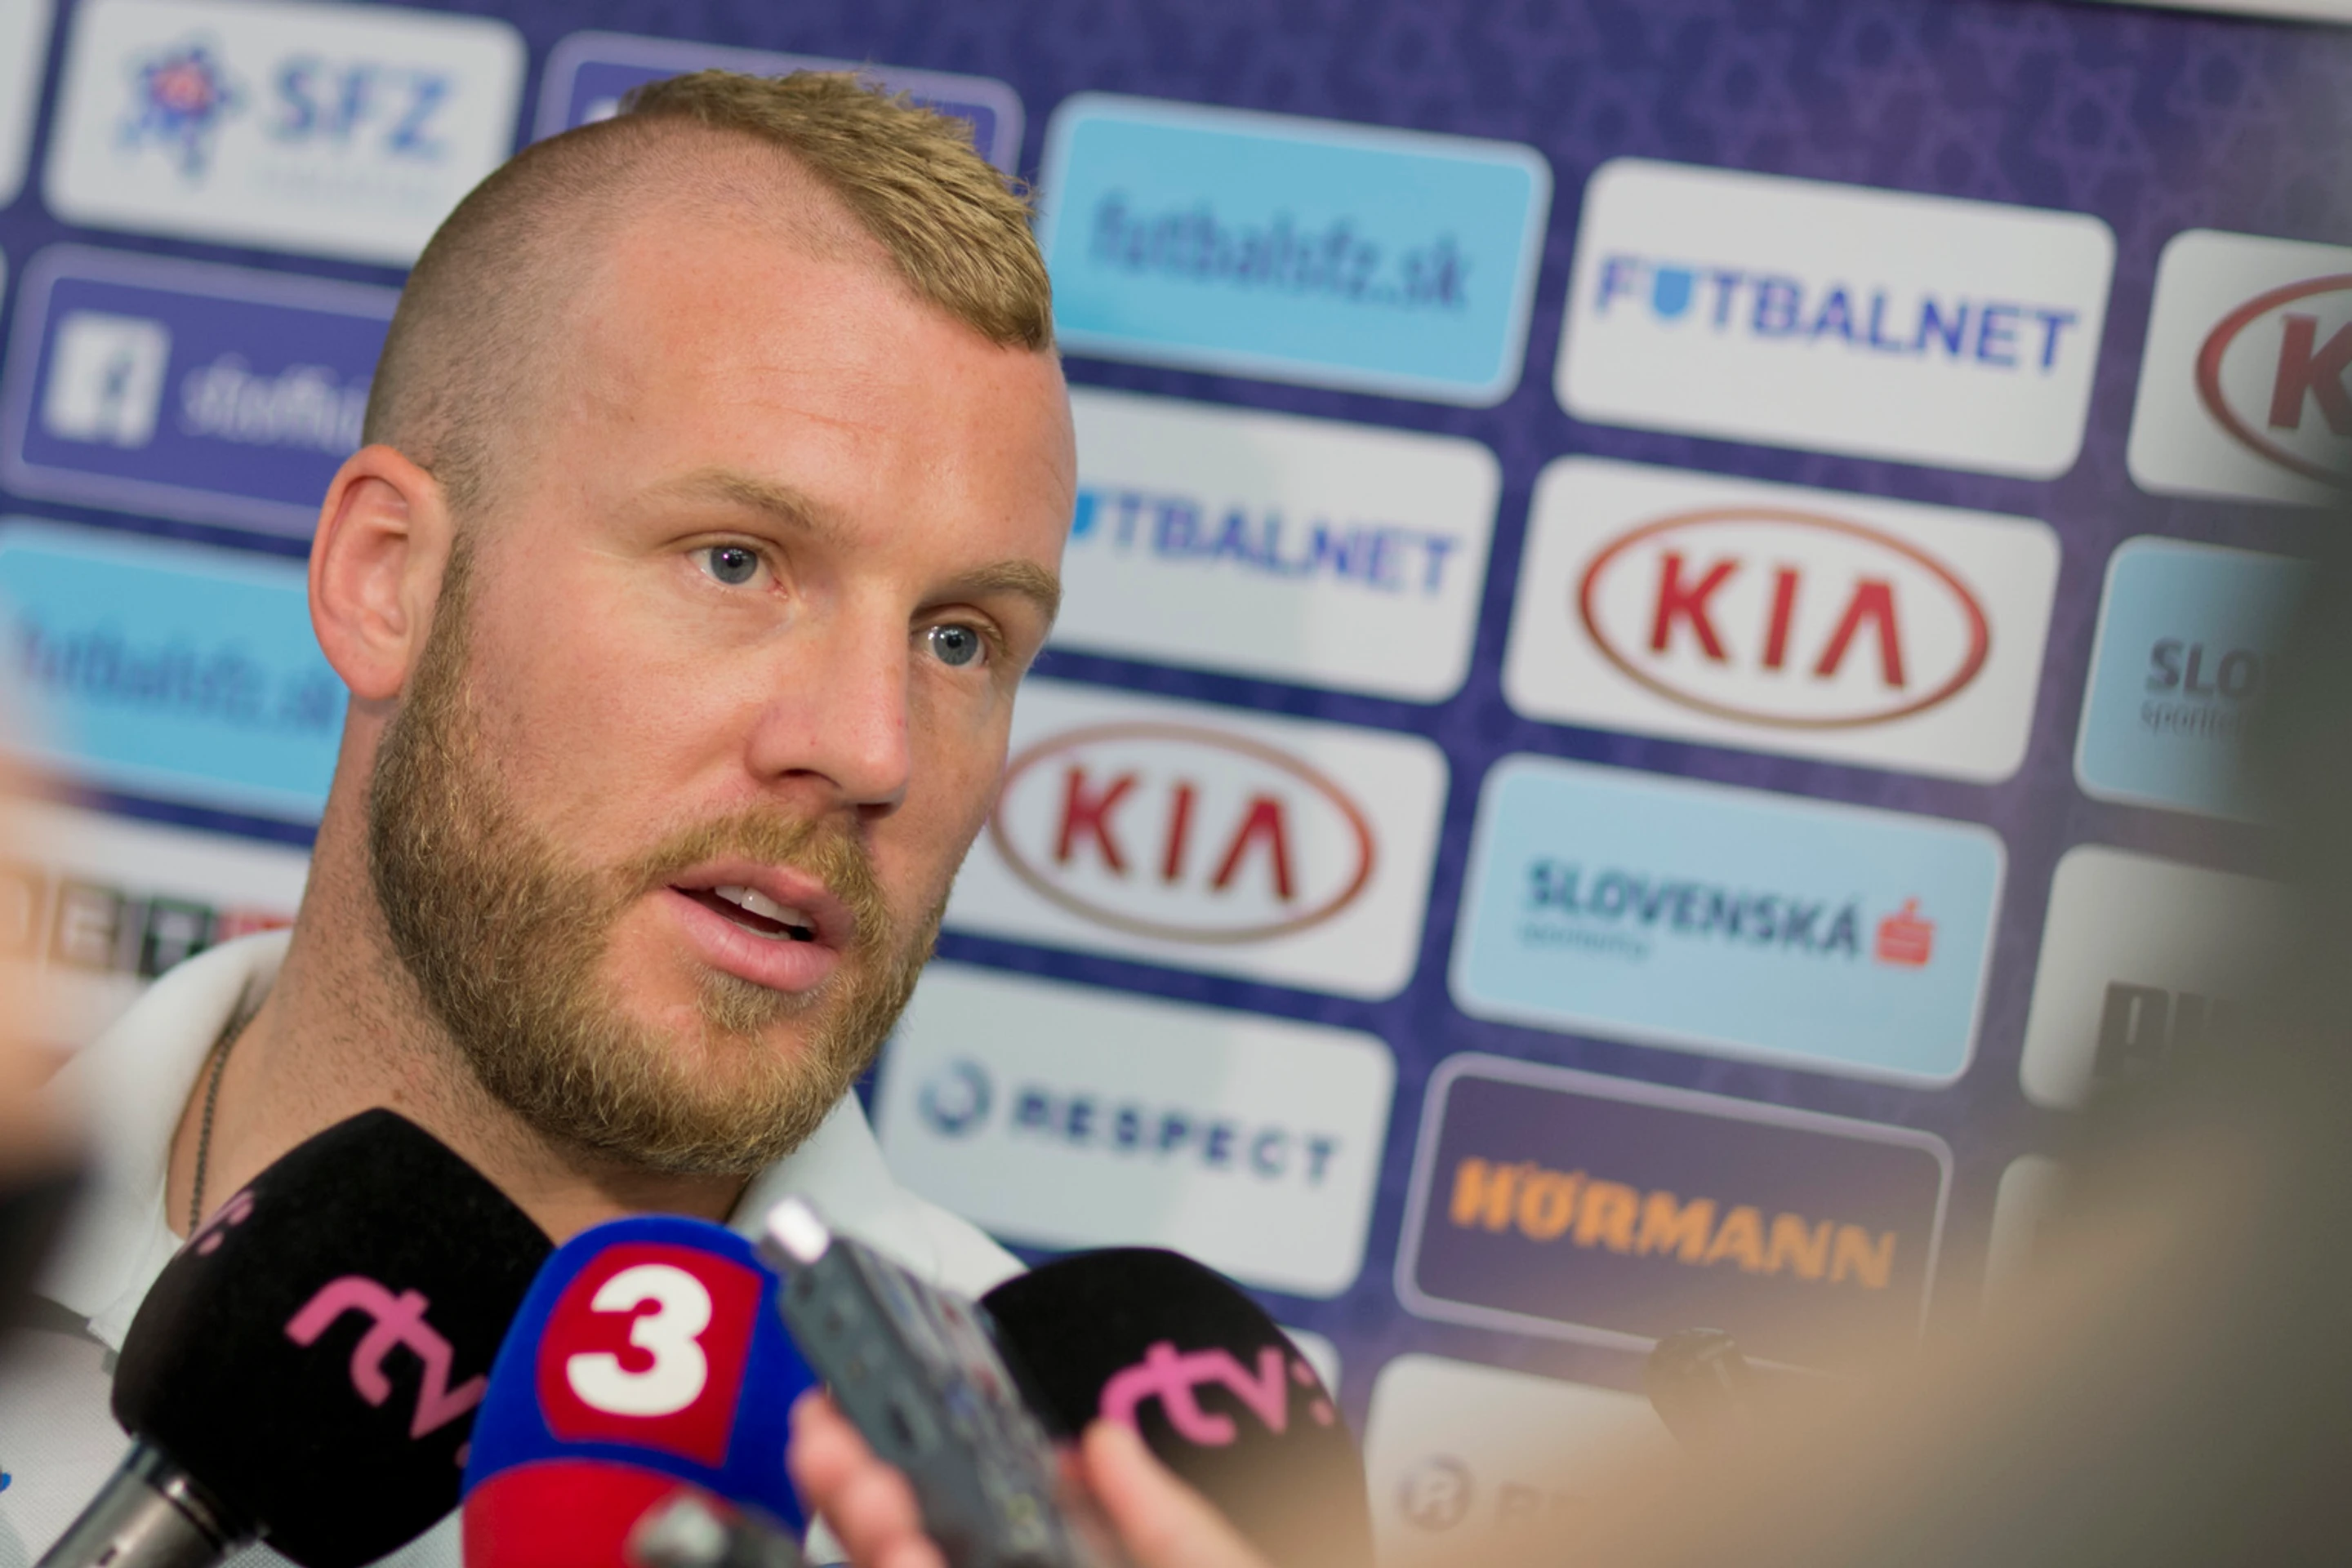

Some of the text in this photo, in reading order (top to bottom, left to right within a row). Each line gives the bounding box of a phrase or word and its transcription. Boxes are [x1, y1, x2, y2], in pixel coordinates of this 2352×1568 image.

[263, 51, 459, 165] SFZ
[1088, 188, 1471, 317] futbalsfz.sk
[1593, 251, 2079, 376] FUTBALNET
[1645, 547, 1909, 693] KIA
[1052, 763, 1297, 902] KIA
[1011, 1082, 1345, 1187] RESPECT
[565, 1263, 713, 1418] 3
